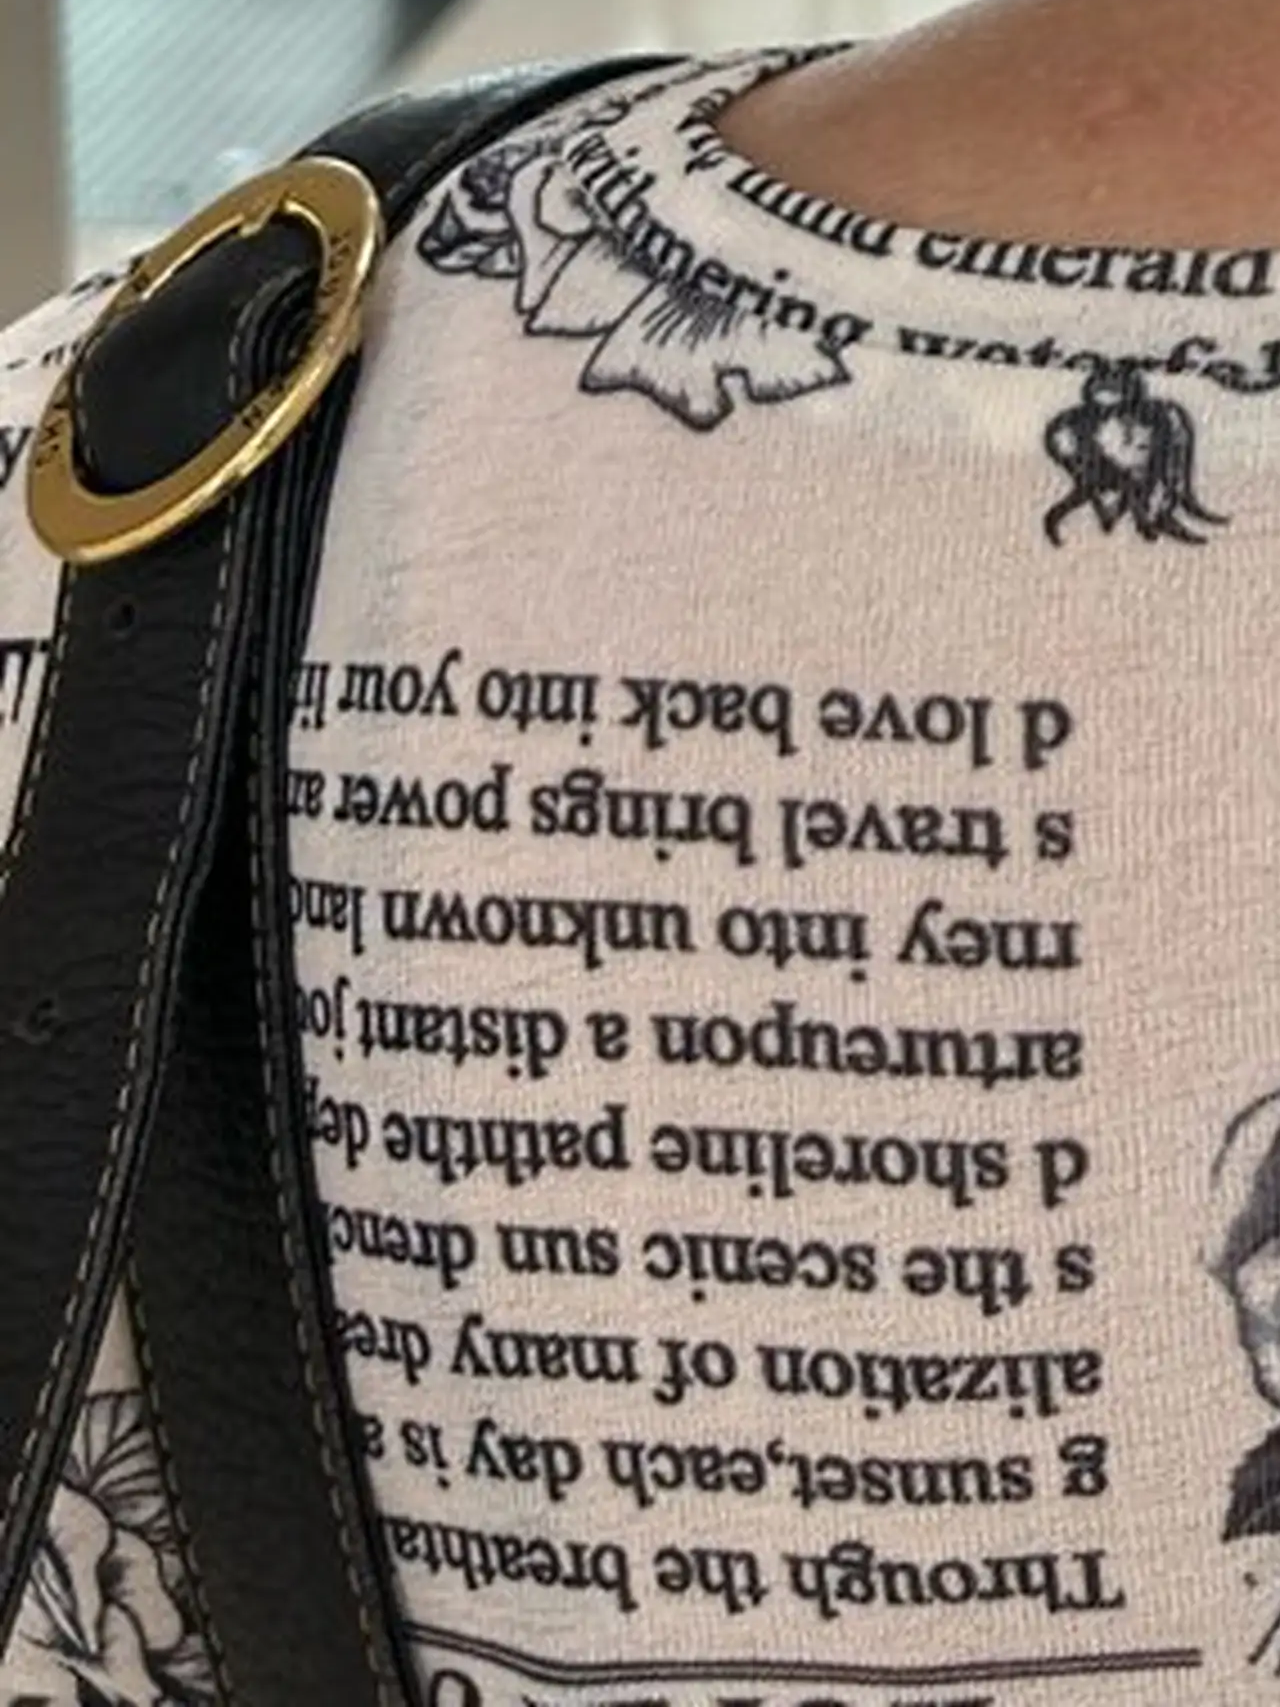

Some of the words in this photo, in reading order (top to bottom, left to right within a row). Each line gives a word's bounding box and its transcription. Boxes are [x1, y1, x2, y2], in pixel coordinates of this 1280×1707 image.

[337, 647, 463, 717] your
[476, 668, 600, 747] into
[620, 676, 800, 758] back
[817, 689, 994, 770] love
[1018, 698, 1071, 771] d
[334, 762, 514, 832] power
[530, 768, 756, 868] brings
[779, 798, 1010, 870] travel
[1034, 809, 1074, 861] s
[379, 890, 697, 971] unknown
[717, 906, 871, 984] into
[897, 897, 1081, 971] rney
[356, 998, 568, 1080] distant
[585, 1011, 630, 1061] a
[652, 999, 1083, 1090] artureupon
[382, 1102, 630, 1187] paththe
[650, 1123, 1011, 1209] shoreline
[1032, 1138, 1089, 1210] d
[327, 1204, 477, 1289] drenc
[498, 1224, 621, 1276] sun
[643, 1231, 878, 1303] scenic
[901, 1245, 1032, 1317] the
[1056, 1244, 1096, 1292] s
[450, 1312, 641, 1384] many
[653, 1337, 737, 1405] of
[755, 1344, 1103, 1421] alization
[400, 1419, 449, 1489] is
[466, 1417, 583, 1502] day
[601, 1437, 1035, 1509] sunset,each
[1058, 1433, 1110, 1497] g
[378, 1513, 639, 1613] breathta
[653, 1545, 768, 1615] the
[782, 1540, 1126, 1620] Through
